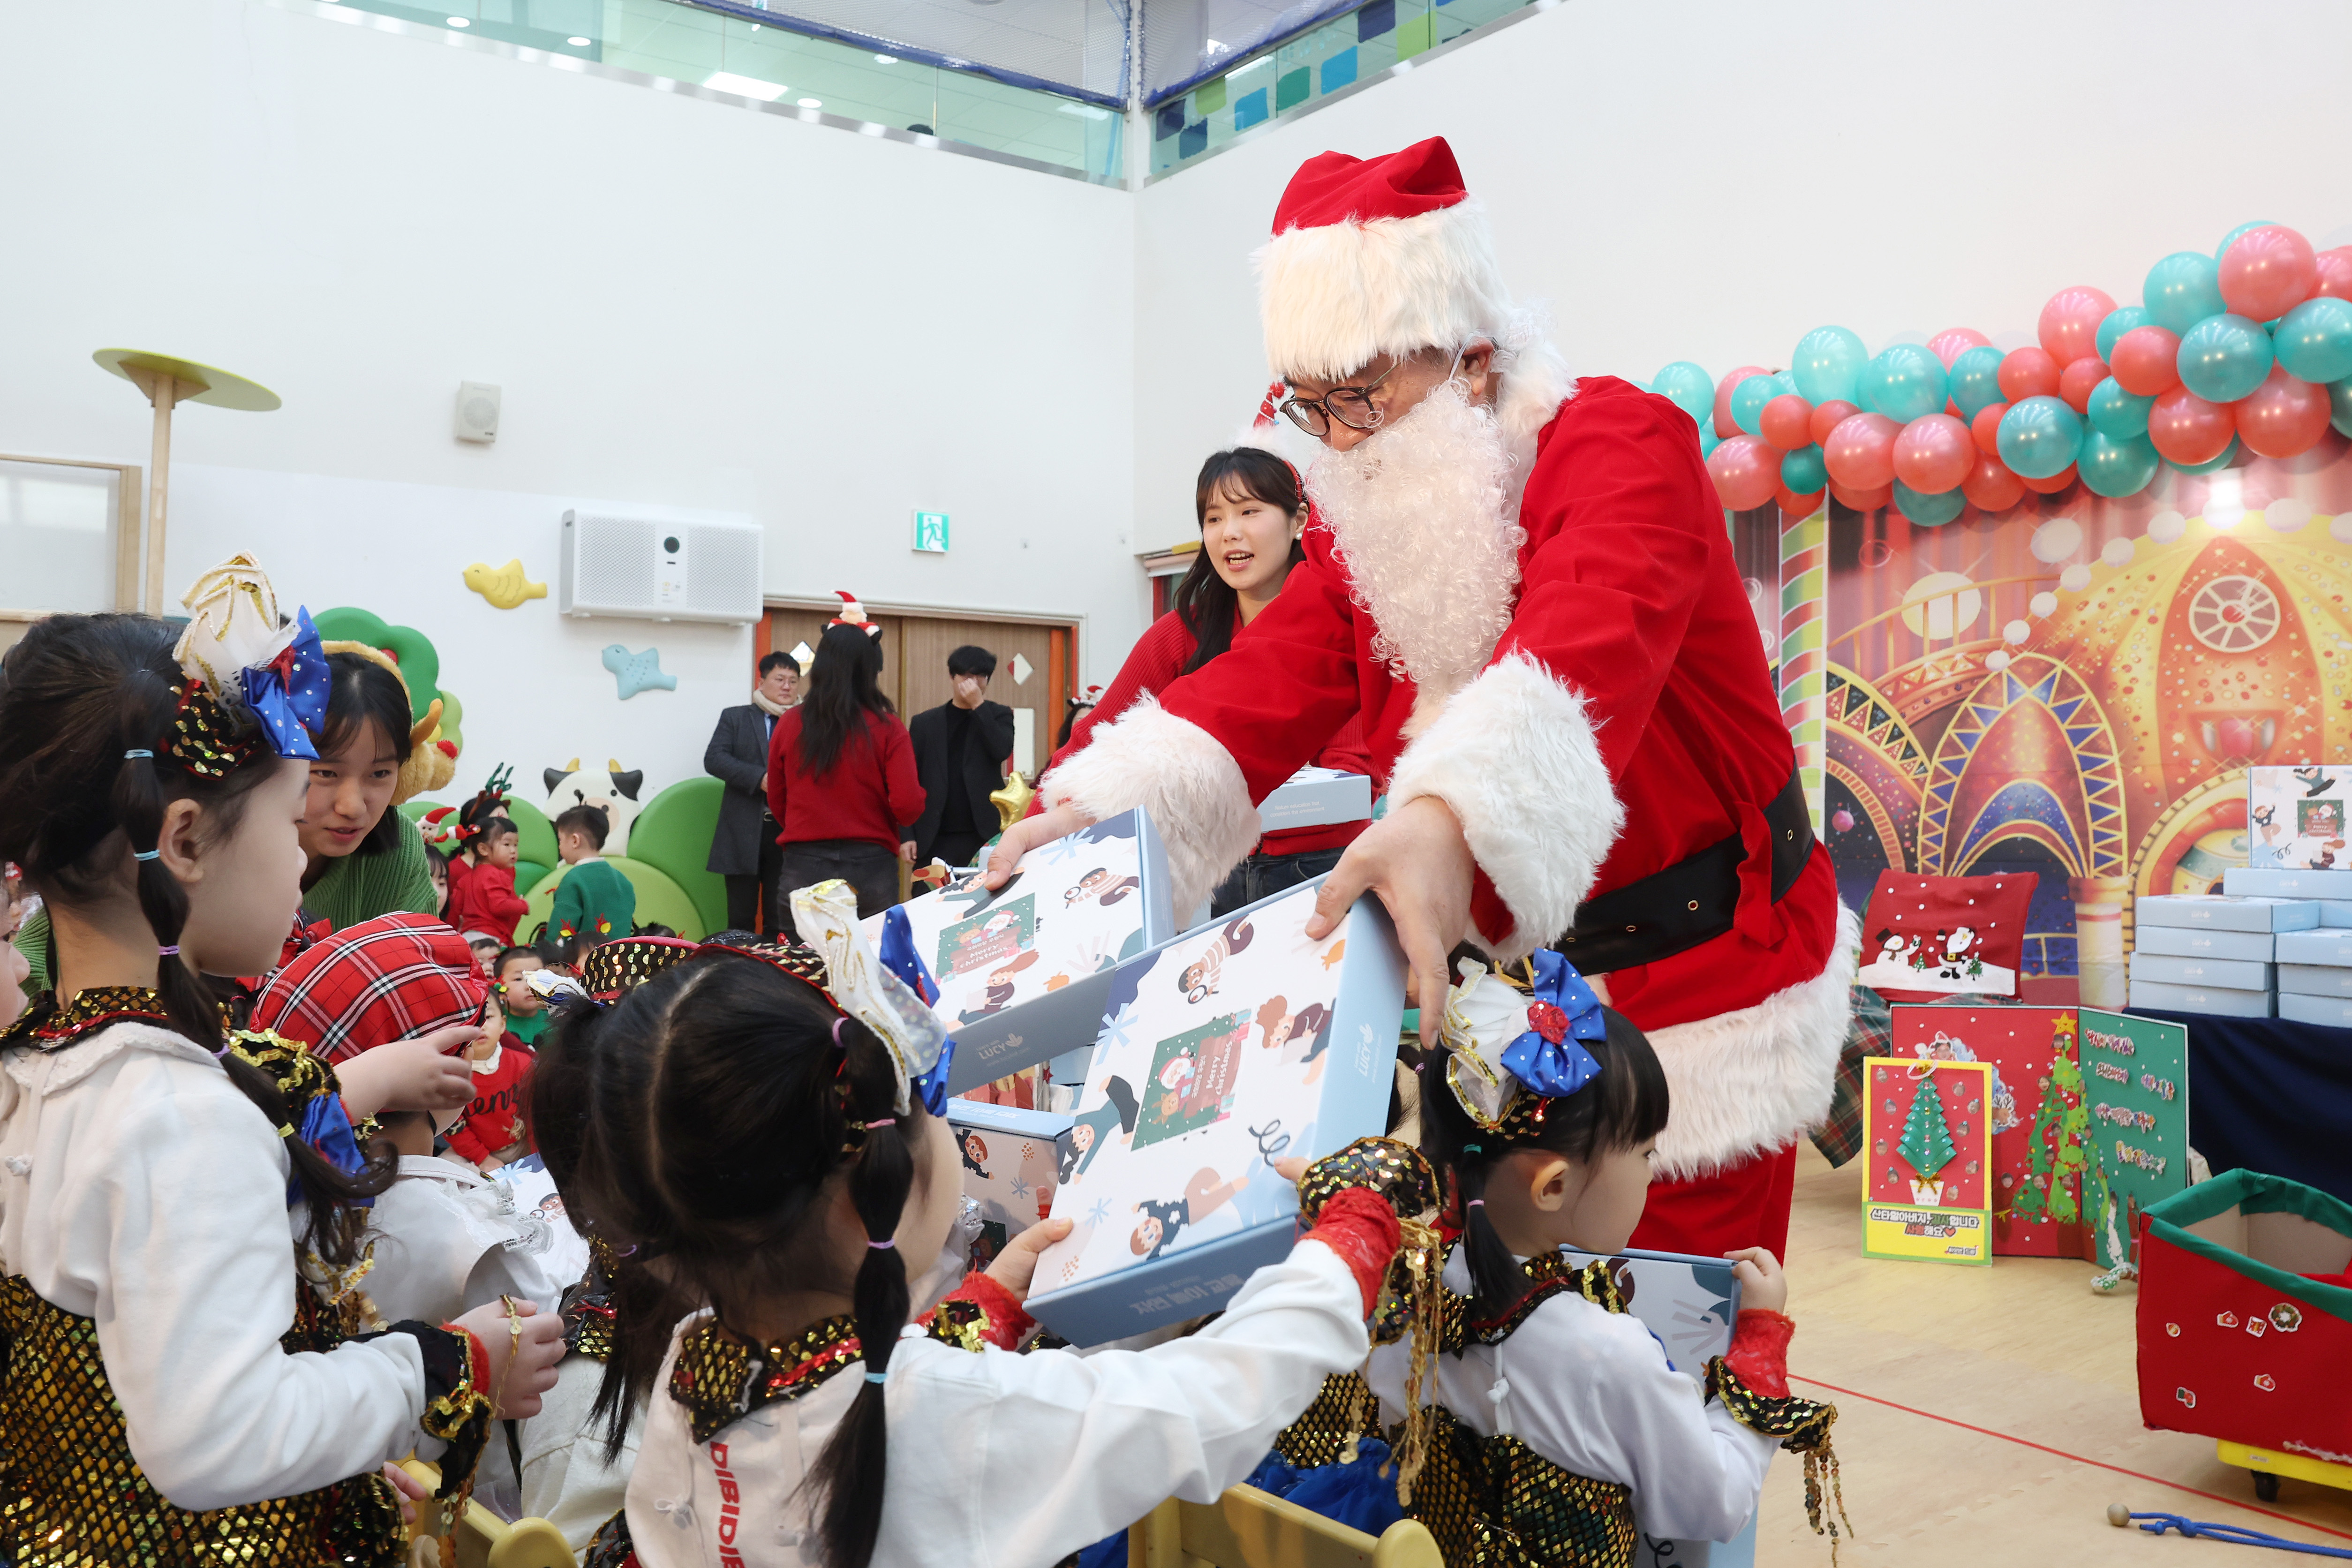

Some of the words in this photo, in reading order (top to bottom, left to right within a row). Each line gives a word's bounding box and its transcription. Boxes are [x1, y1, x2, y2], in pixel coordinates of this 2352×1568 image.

[959, 946, 1008, 968] christmas
[970, 943, 999, 958] Merry
[978, 1043, 1006, 1060] LUCY
[1358, 1043, 1371, 1077] LUCY
[1206, 1055, 1221, 1089] Merry
[1215, 1041, 1232, 1095] christmas
